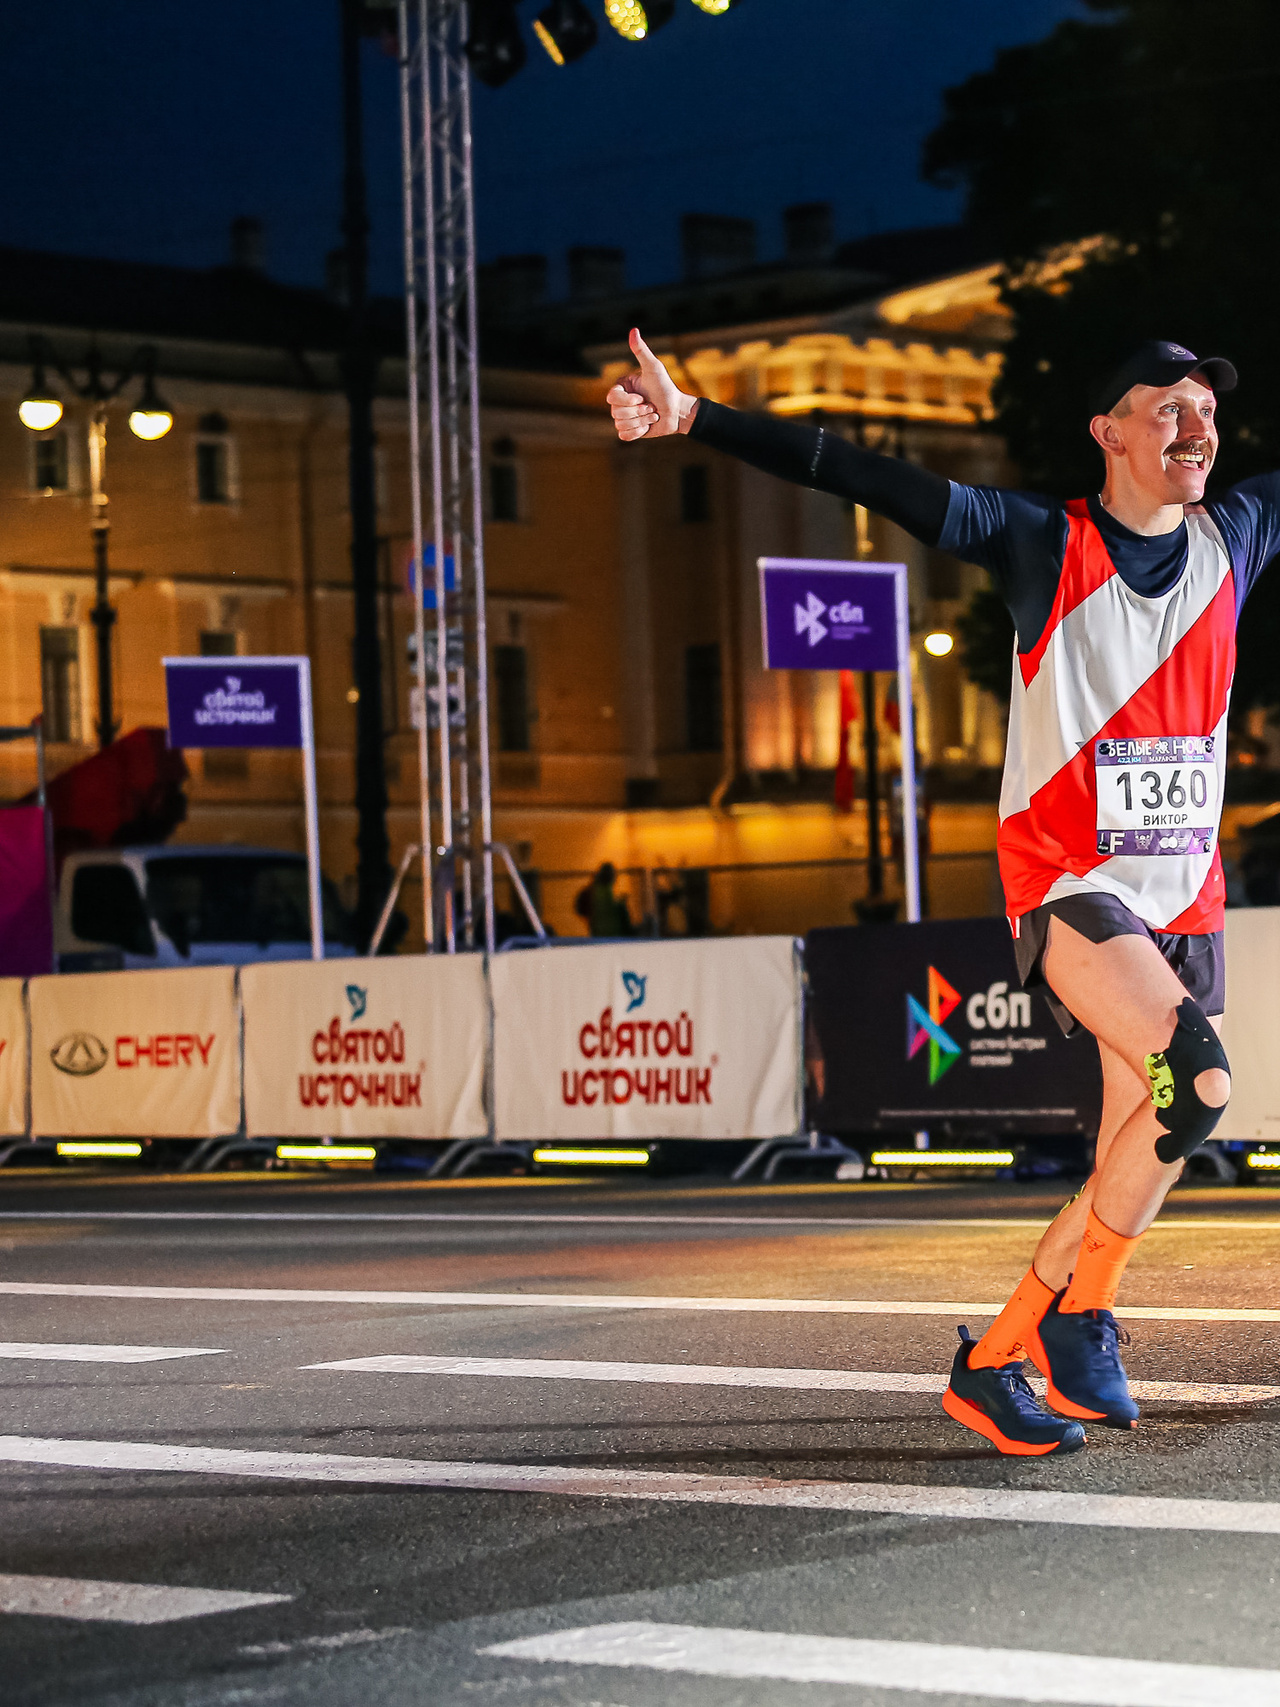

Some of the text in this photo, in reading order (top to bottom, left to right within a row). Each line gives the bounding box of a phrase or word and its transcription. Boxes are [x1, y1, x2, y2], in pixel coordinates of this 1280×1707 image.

[1108, 741, 1152, 757] БЕЛЫЕ
[1116, 769, 1208, 811] 1360
[1143, 813, 1188, 826] ВИКТОР
[1109, 832, 1125, 854] F
[967, 981, 1031, 1030] сбп
[115, 1034, 215, 1068] CHERY
